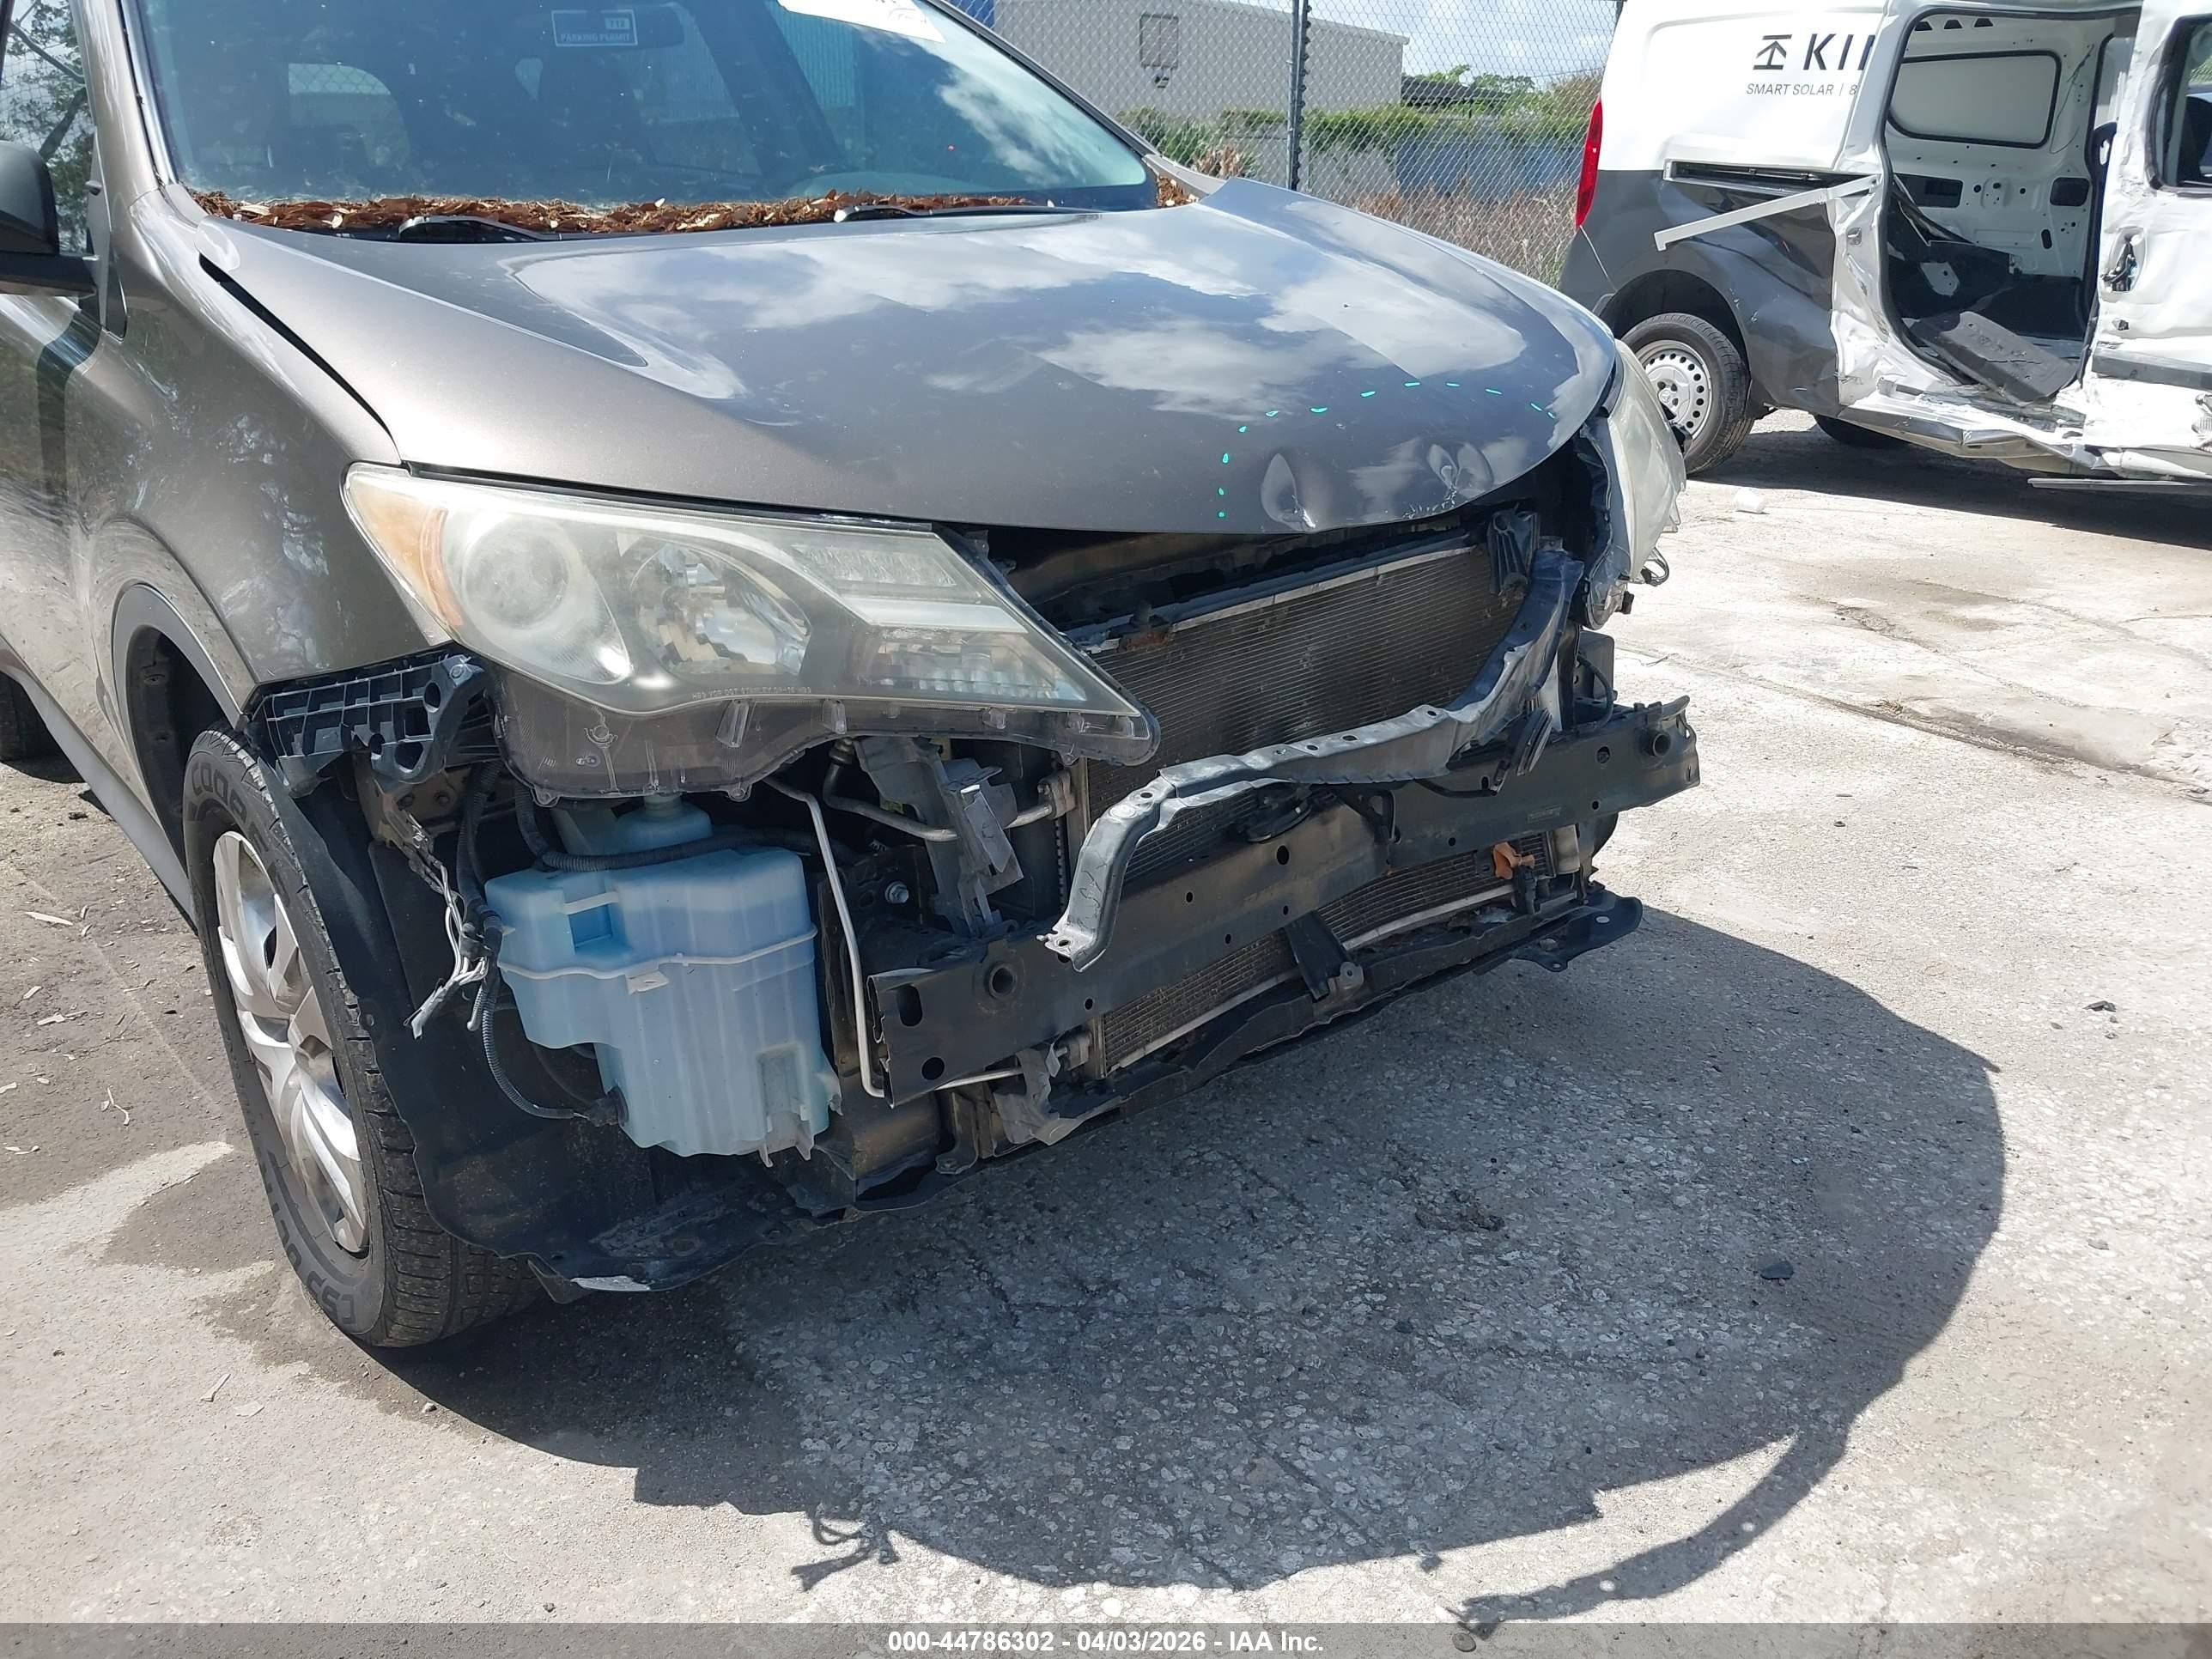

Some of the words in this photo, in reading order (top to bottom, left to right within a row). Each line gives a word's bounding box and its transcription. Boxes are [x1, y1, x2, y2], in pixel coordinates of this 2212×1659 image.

[560, 33, 598, 42] PARKING
[599, 33, 630, 42] PERMIT
[1746, 83, 1791, 95] SMART
[1792, 83, 1834, 96] SOLAR
